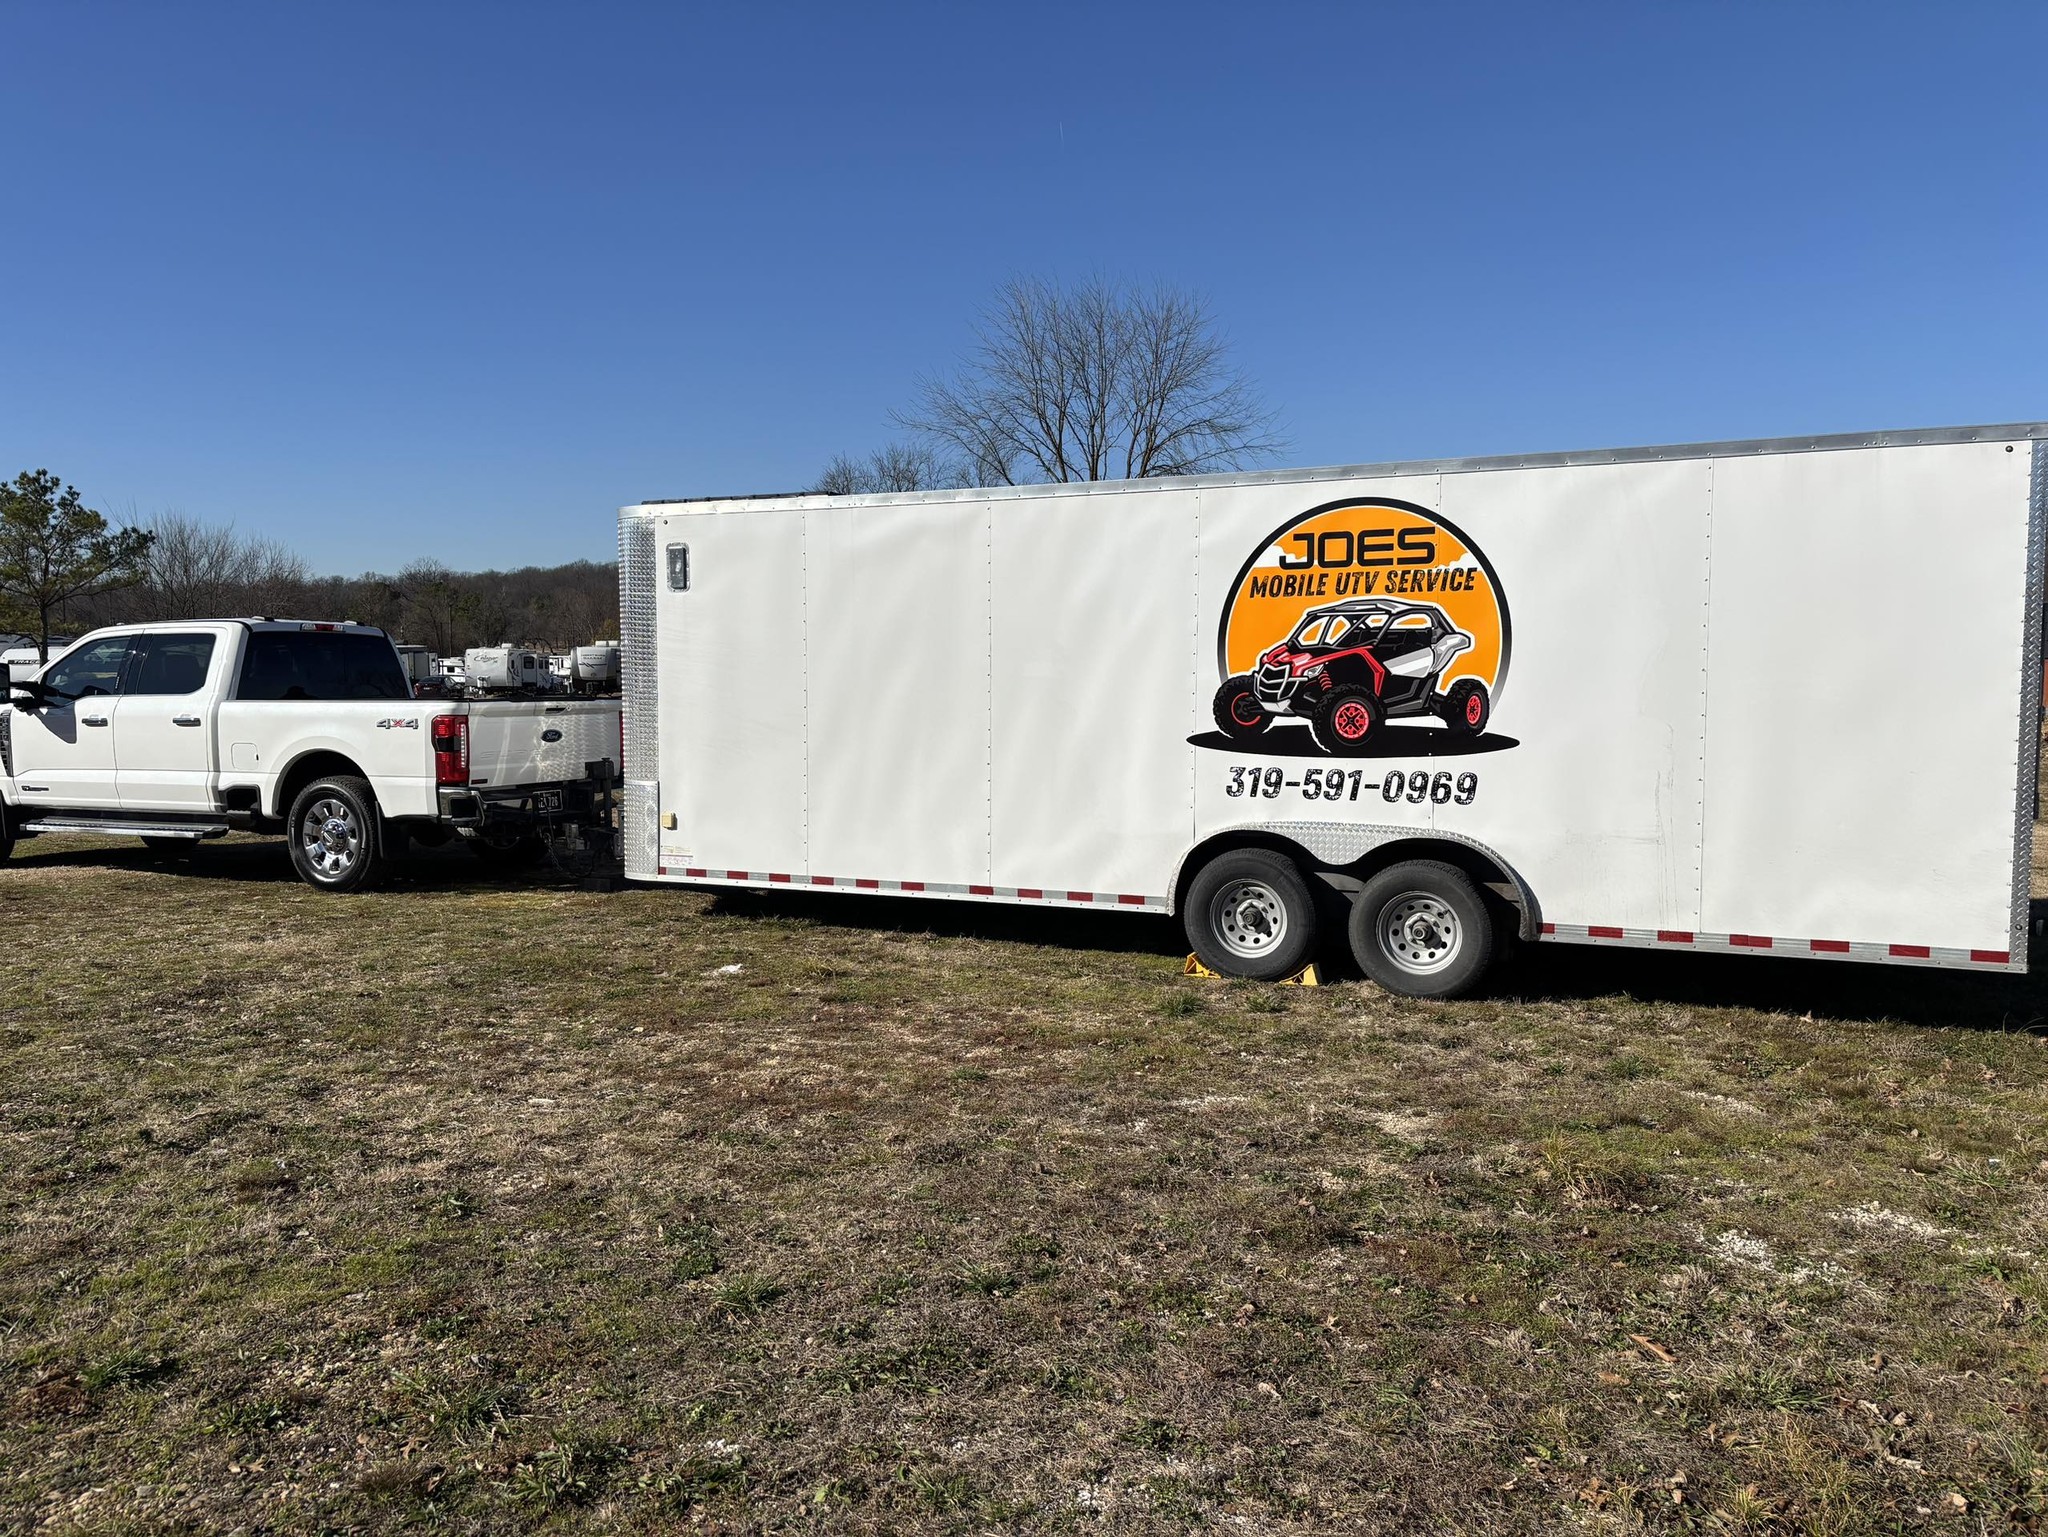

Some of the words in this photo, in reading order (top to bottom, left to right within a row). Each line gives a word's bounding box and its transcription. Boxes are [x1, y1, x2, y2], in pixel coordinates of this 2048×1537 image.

[1279, 526, 1436, 571] JOES
[1249, 572, 1330, 599] MOBILE
[1335, 570, 1380, 595] UTV
[1384, 567, 1477, 593] SERVICE
[1225, 766, 1479, 806] 319-591-0969
